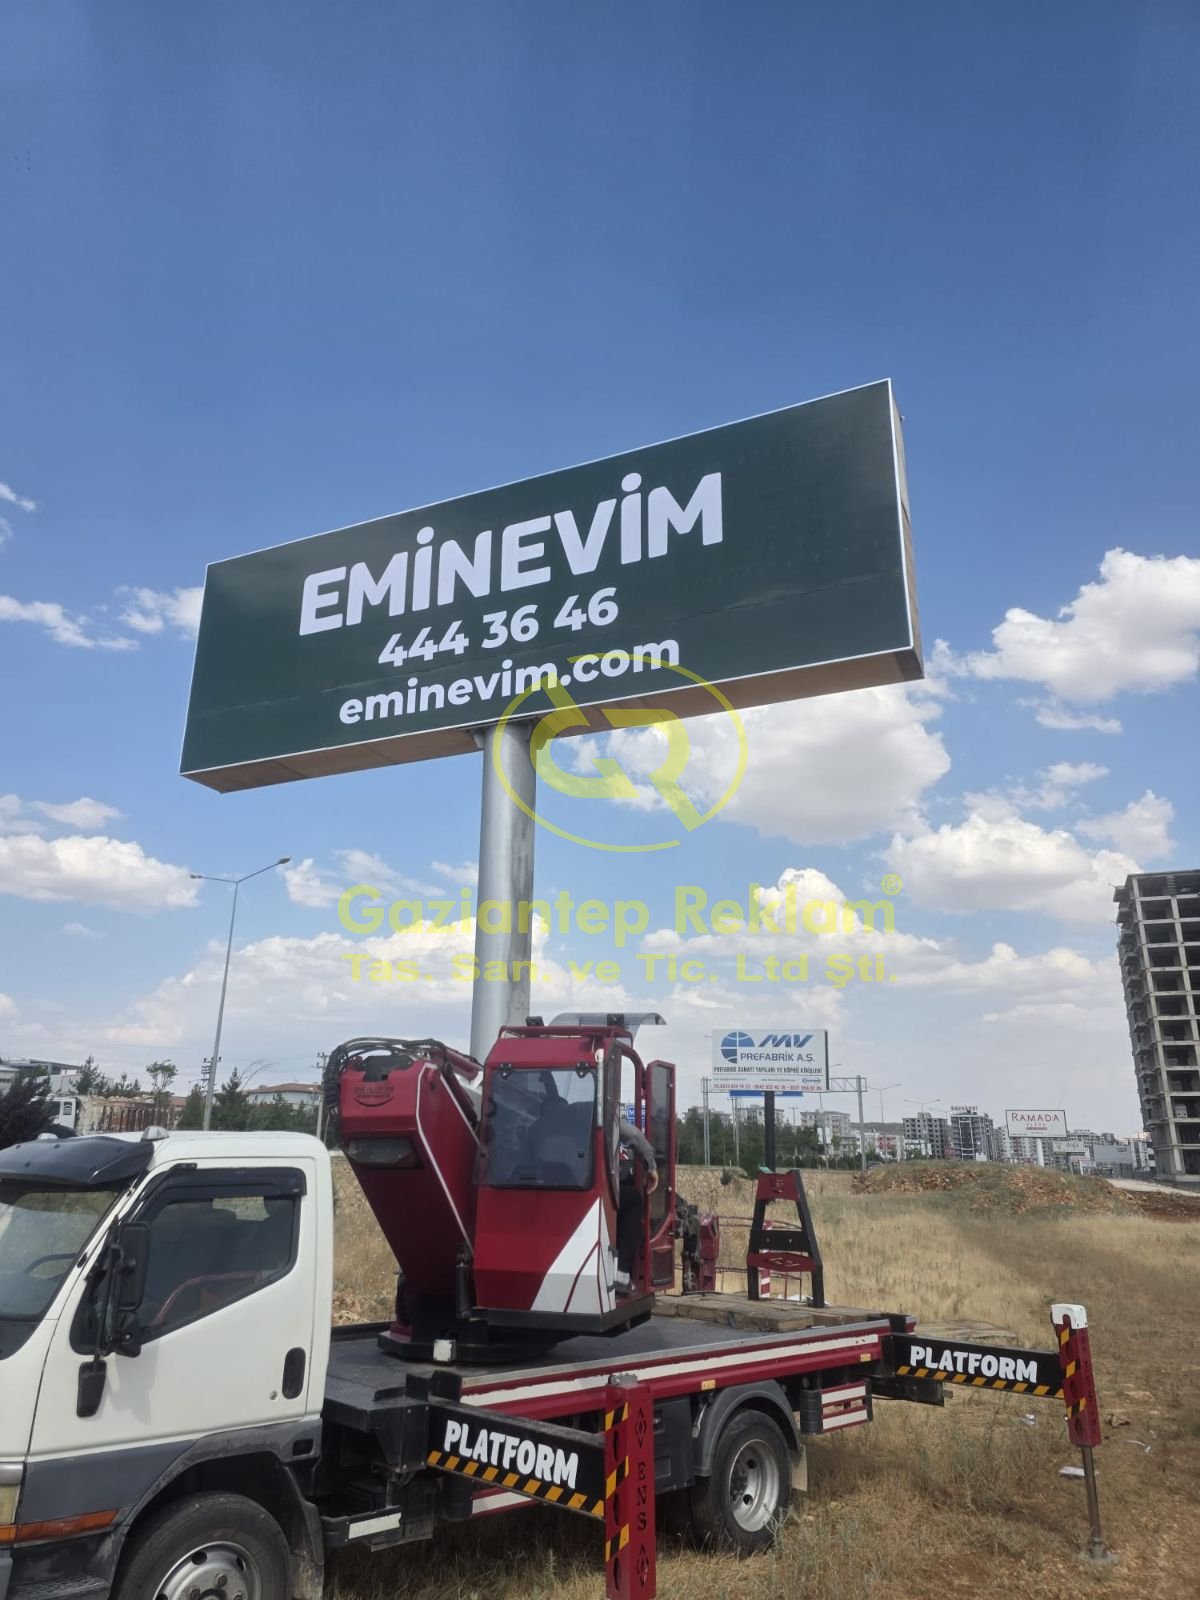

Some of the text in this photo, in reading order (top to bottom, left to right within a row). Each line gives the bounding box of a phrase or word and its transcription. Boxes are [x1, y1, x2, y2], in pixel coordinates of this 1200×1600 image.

[299, 472, 724, 637] EMİNEVİM
[378, 587, 619, 667] 444 36 46
[339, 639, 680, 724] eminevim.com
[740, 1052, 794, 1062] PREFABRİK
[1011, 1112, 1060, 1122] RAMADA
[909, 1344, 1038, 1384] PLATFORM
[443, 1419, 580, 1489] PLATFORM
